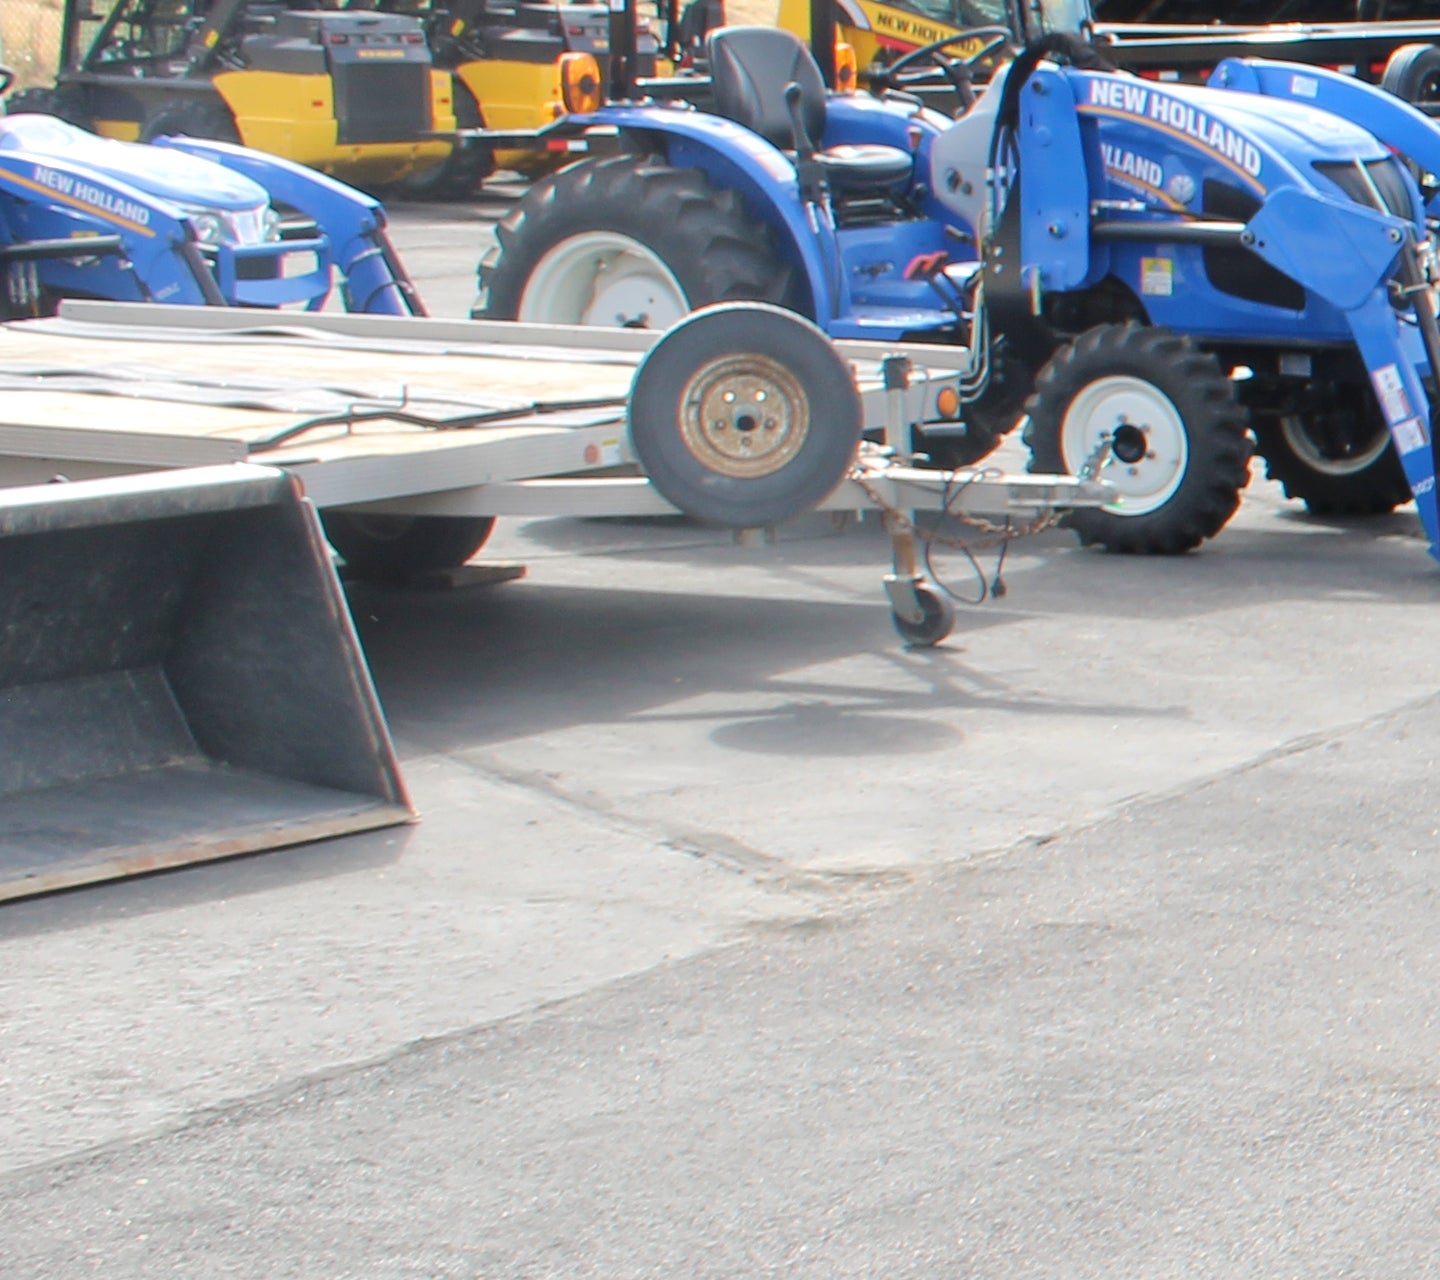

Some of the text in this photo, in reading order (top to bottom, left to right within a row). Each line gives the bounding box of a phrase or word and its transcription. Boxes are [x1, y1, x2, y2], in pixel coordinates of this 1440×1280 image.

[911, 24, 979, 52] HOLLND
[1090, 78, 1262, 178] NEW HOLLAND
[34, 166, 150, 226] NEW HOLLAND
